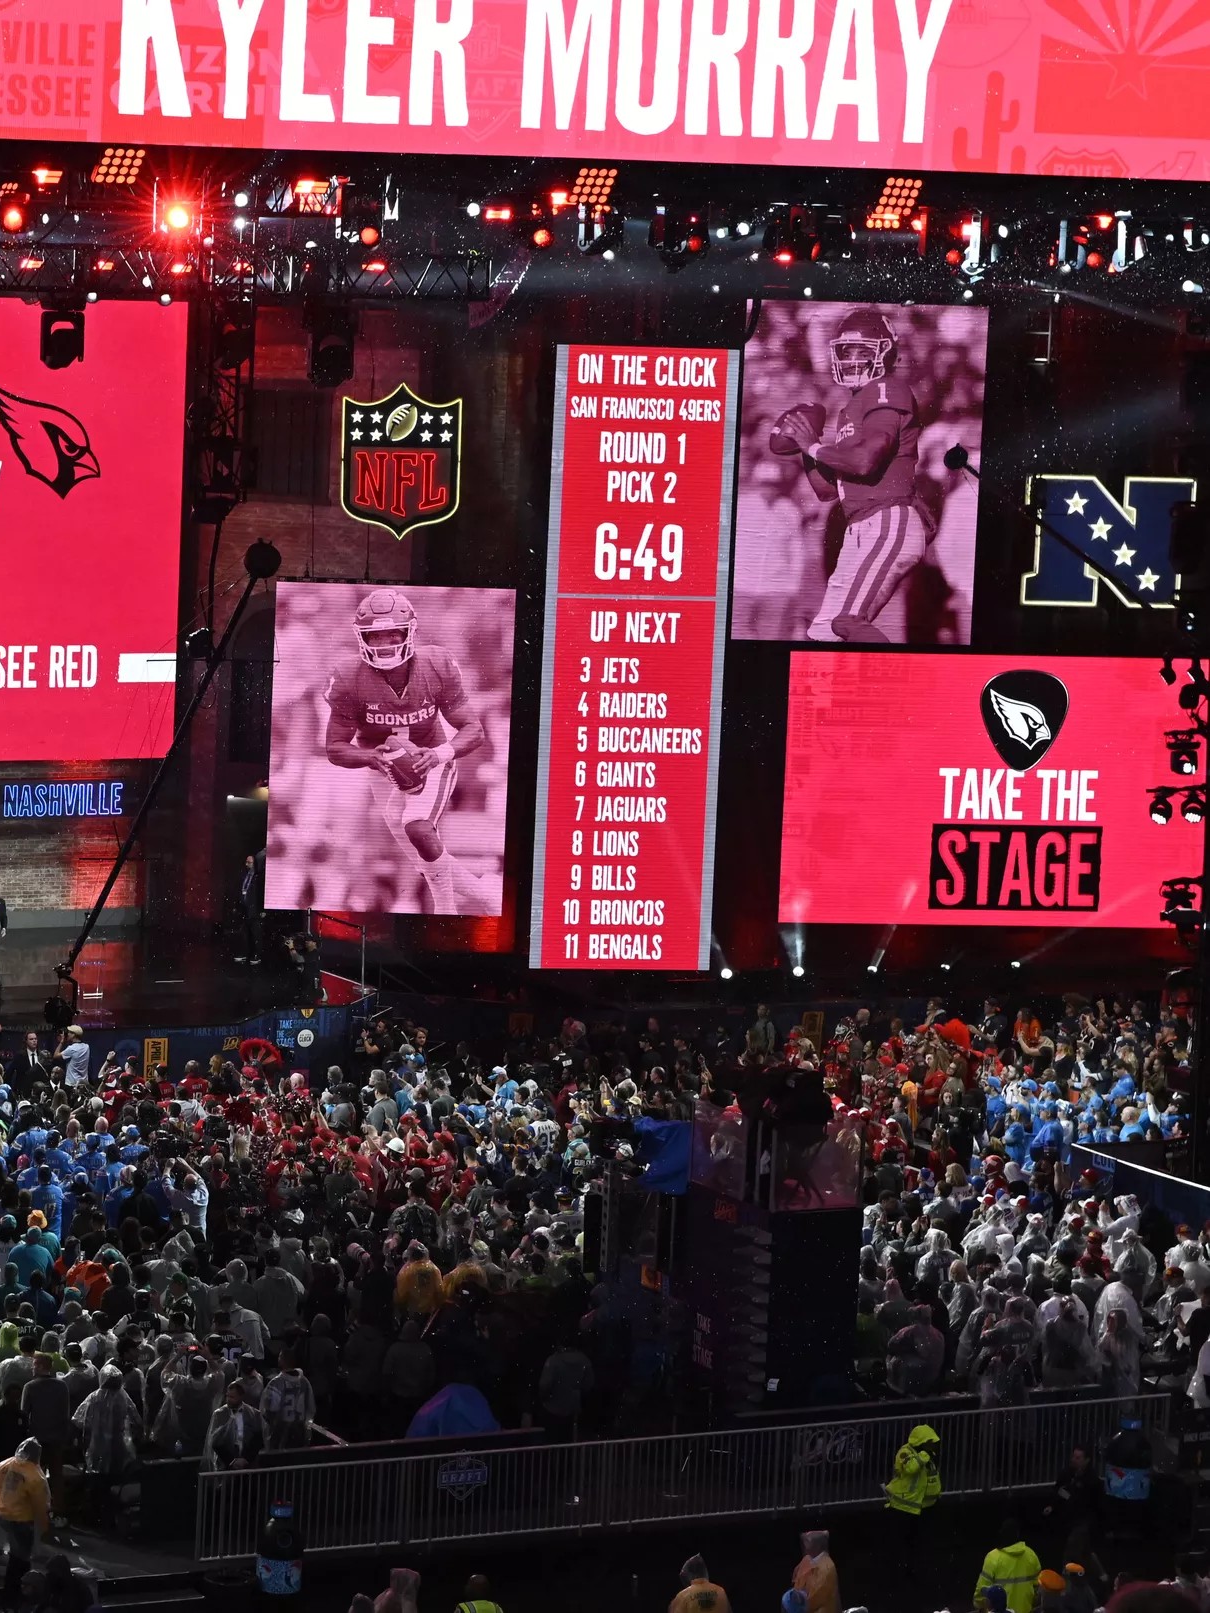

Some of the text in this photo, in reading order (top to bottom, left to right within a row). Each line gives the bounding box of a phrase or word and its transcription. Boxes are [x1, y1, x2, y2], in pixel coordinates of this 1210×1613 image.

[118, 0, 953, 144] KYLER MURRAY
[578, 353, 717, 387] ON THE CLOCK
[877, 382, 889, 404] 1
[570, 396, 721, 422] SAN FRANCISCO 49ERS
[599, 431, 687, 464] ROUND 1
[353, 450, 447, 518] NFL
[606, 471, 677, 504] PICK 2
[594, 522, 684, 581] 6:49
[590, 611, 681, 643] UP NEXT
[48, 644, 98, 688] RED
[580, 656, 640, 684] 3 JETS
[365, 704, 436, 726] SOONERS
[577, 691, 667, 718] 4 RAIDERS
[577, 726, 702, 754] 5 BUCCANEERS
[575, 761, 655, 788] 6 GIANTS
[2, 781, 124, 818] NASHVILLE
[939, 767, 1099, 821] TAKE THE
[575, 796, 667, 823] 7 JAGUARS
[572, 830, 639, 857] 8 LIONS
[570, 864, 636, 891] 9 BILLS
[936, 830, 1098, 908] STAGE
[563, 899, 665, 926] 10 BRONCOS
[564, 933, 662, 960] 11 BENGALS
